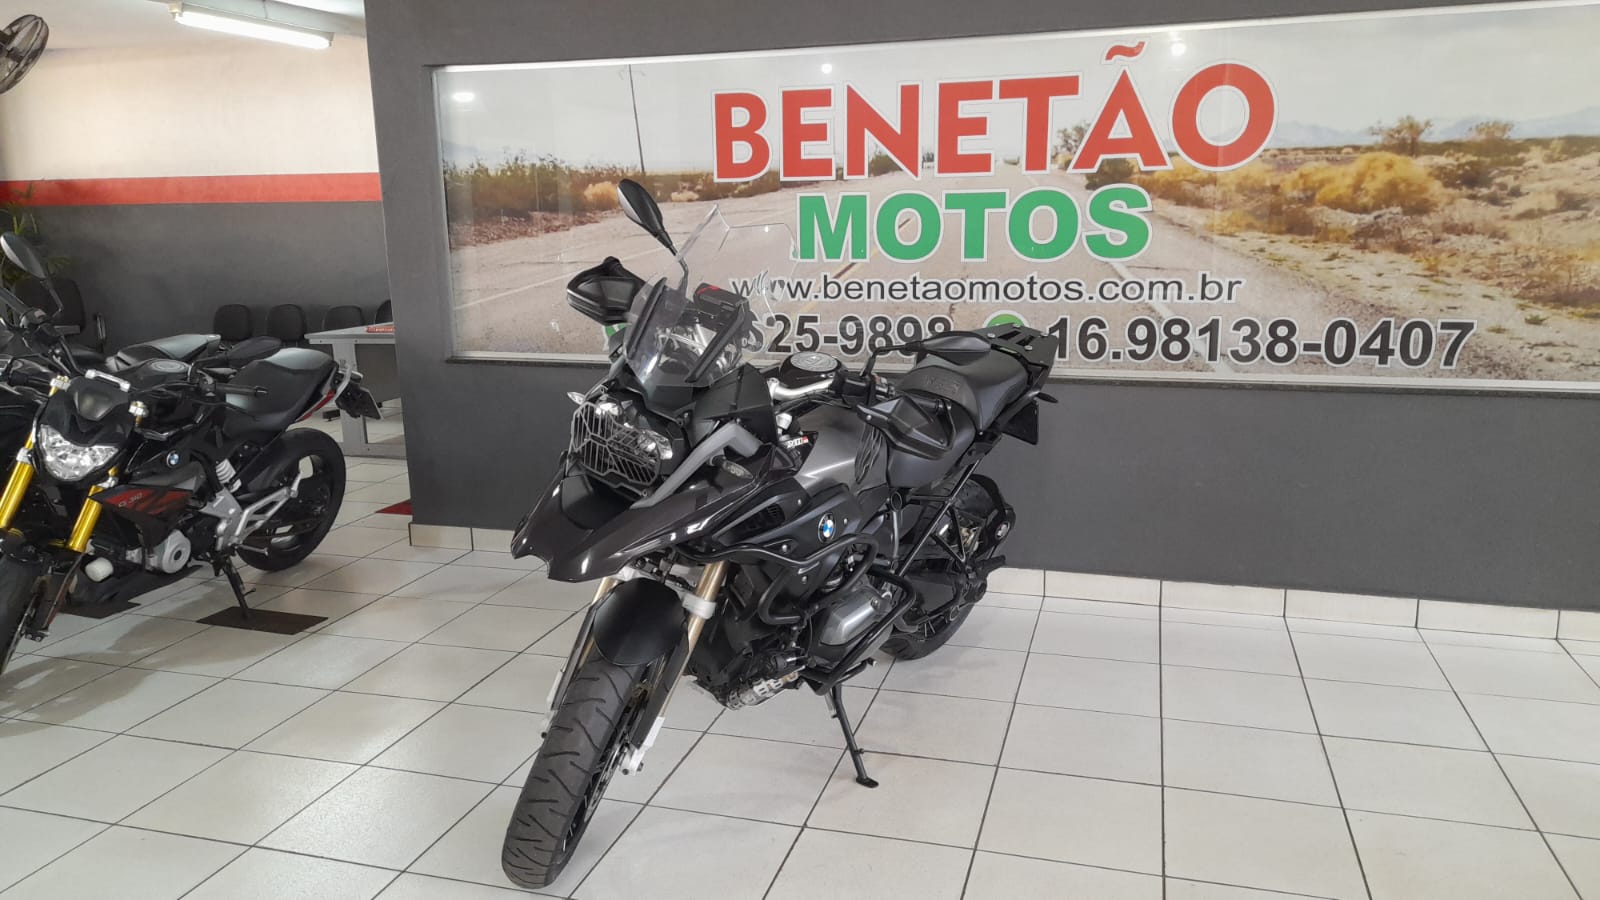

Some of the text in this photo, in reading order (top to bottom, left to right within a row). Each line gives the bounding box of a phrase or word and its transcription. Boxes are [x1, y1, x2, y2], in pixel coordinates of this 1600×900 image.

[713, 41, 1277, 181] BENETÃO
[798, 190, 1152, 261] MOTOS
[731, 272, 1242, 302] www.benetaomotos.com.br
[1049, 315, 1477, 369] 16.98138-0407
